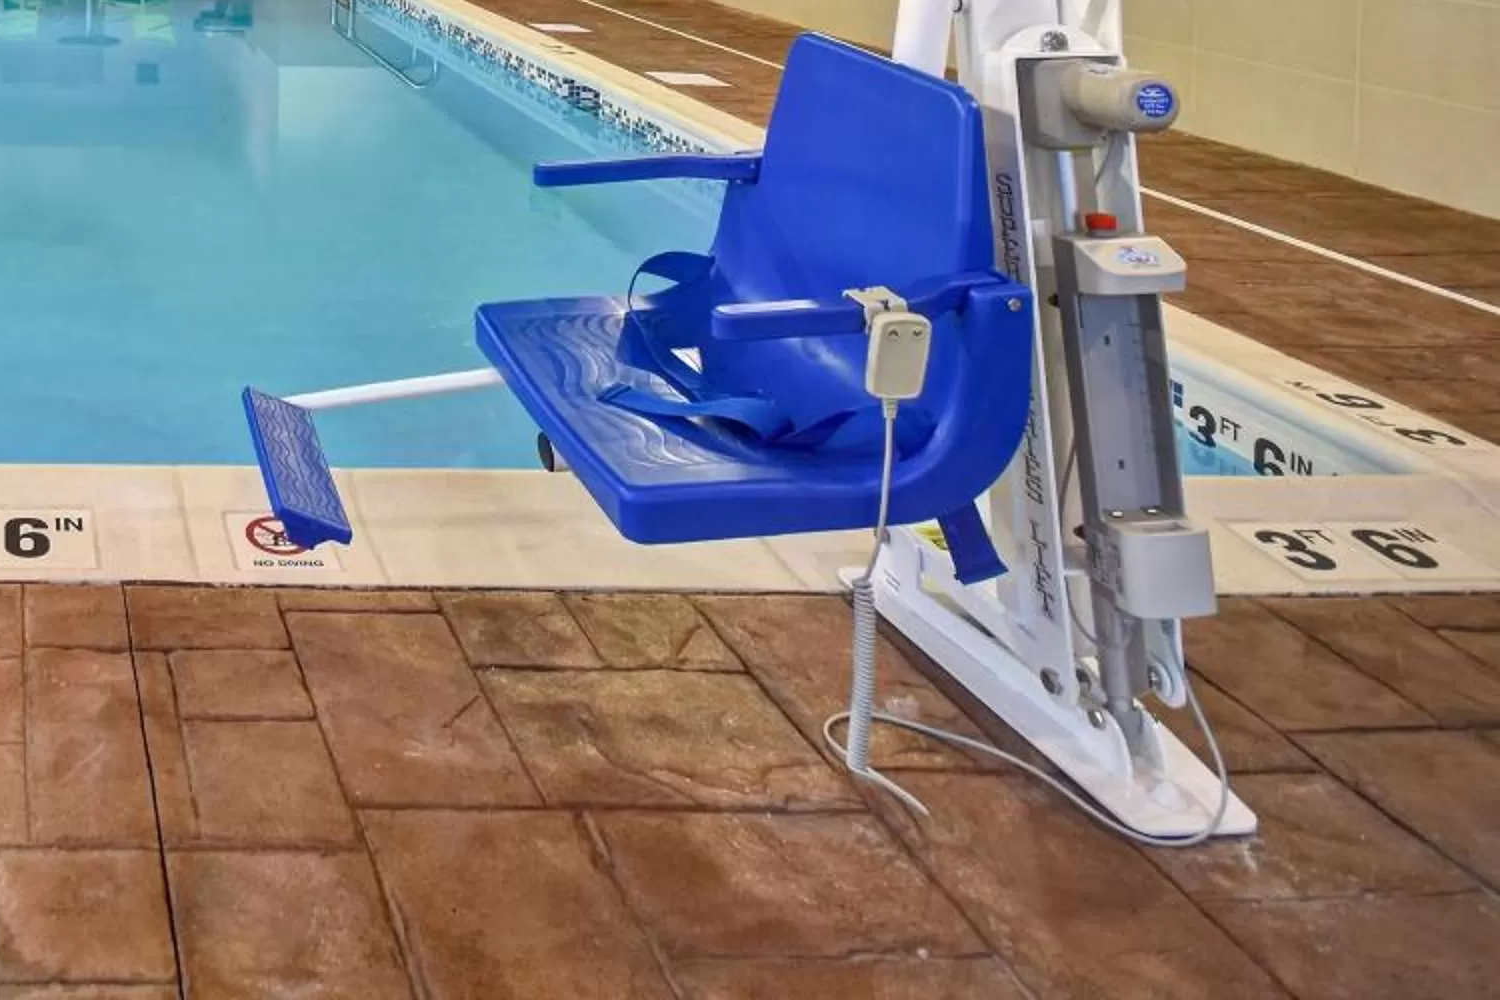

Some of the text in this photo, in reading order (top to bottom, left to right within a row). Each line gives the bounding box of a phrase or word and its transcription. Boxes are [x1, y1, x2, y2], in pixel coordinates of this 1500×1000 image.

[1189, 405, 1313, 476] 3 FT 6 IN
[3, 516, 51, 558] 6
[55, 516, 84, 531] IN
[1255, 528, 1439, 571] 3 FT 6 IN
